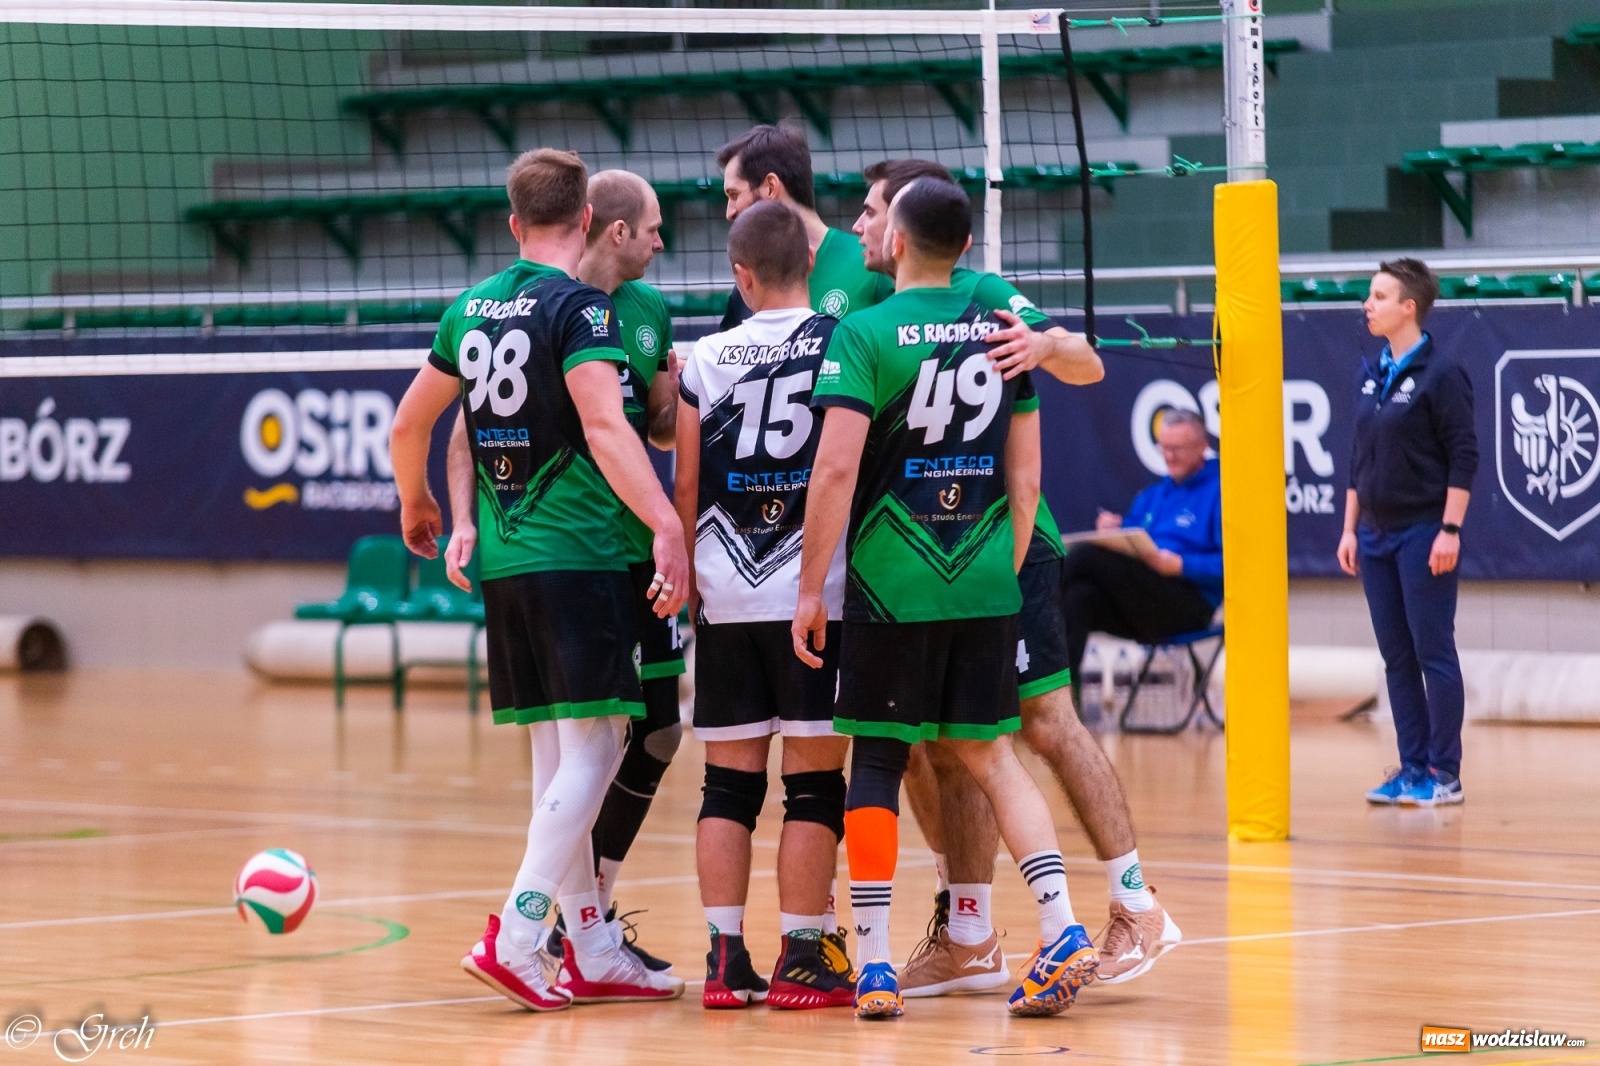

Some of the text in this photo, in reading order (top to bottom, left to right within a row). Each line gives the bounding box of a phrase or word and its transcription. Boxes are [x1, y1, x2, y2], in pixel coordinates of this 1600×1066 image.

[592, 325, 608, 333] PCS
[897, 323, 921, 347] KS
[717, 331, 823, 365] KS RACIBÓRZ
[458, 329, 531, 417] 98
[732, 370, 814, 460] 15
[906, 353, 1003, 446] 49
[0, 397, 132, 483] BÓRZ
[476, 428, 529, 443] NTECO
[905, 456, 994, 478] ENTECO
